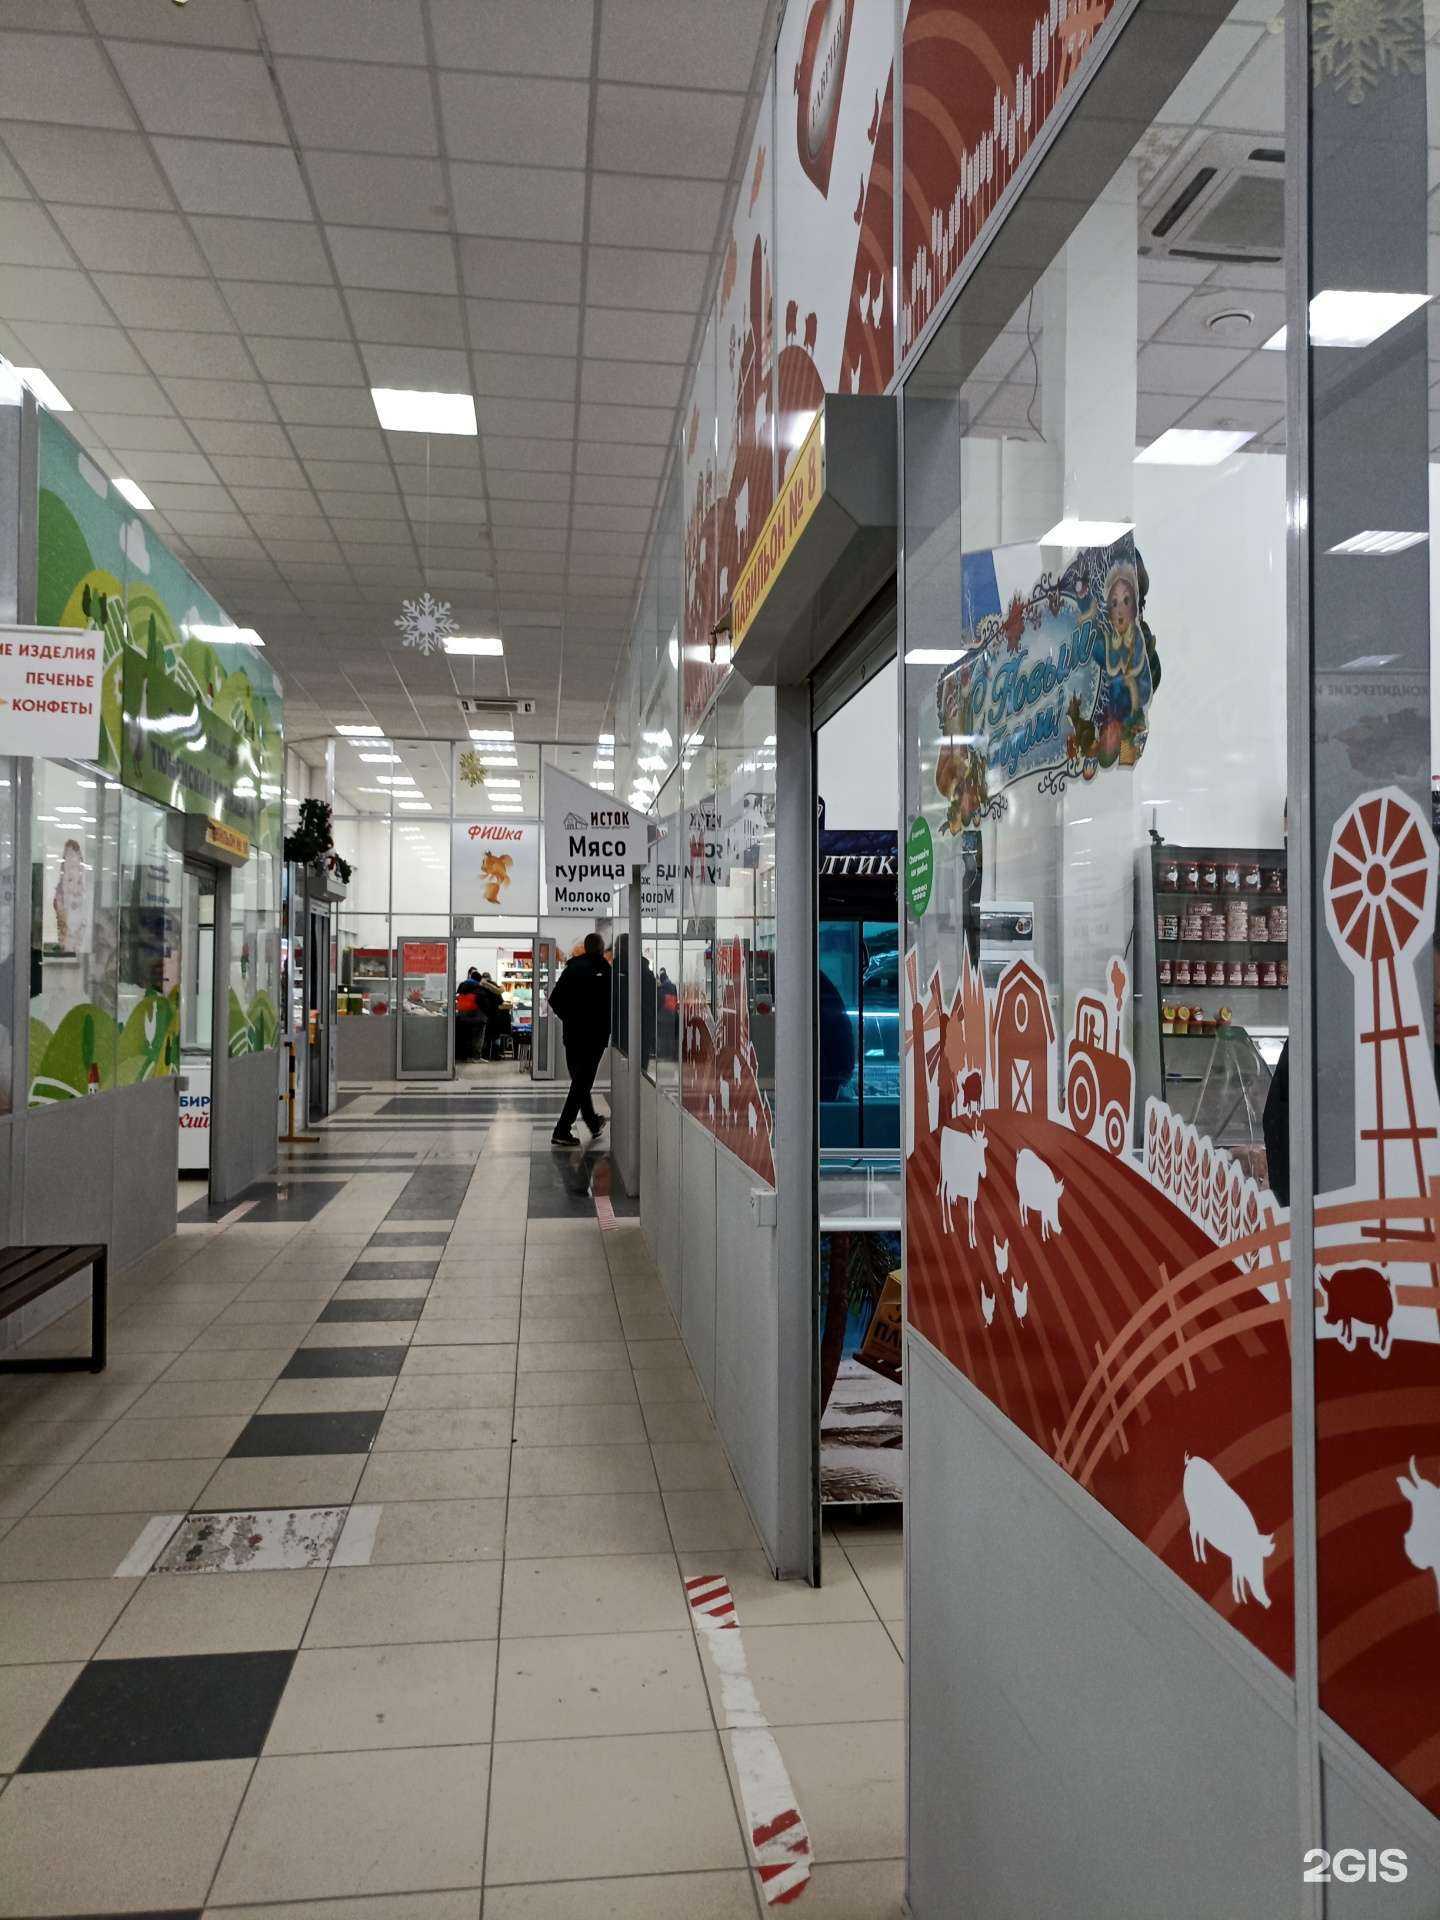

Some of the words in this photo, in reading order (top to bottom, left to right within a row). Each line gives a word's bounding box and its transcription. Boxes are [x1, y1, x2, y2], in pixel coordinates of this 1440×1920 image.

[732, 523, 787, 632] ПАВИЛЬОН
[806, 446, 818, 501] 8
[19, 643, 96, 661] ИЗДЕЛИЯ
[26, 671, 95, 688] ПЕЧЕНЬЕ
[988, 619, 1097, 726] Новым
[12, 698, 93, 715] КОНФЕТЫ
[591, 811, 630, 826] ИСТОК
[467, 824, 524, 841] ФИШка
[569, 835, 627, 858] Мясо
[555, 864, 626, 882] Курица
[818, 855, 898, 875] ЛТИК
[555, 887, 611, 903] Молоко
